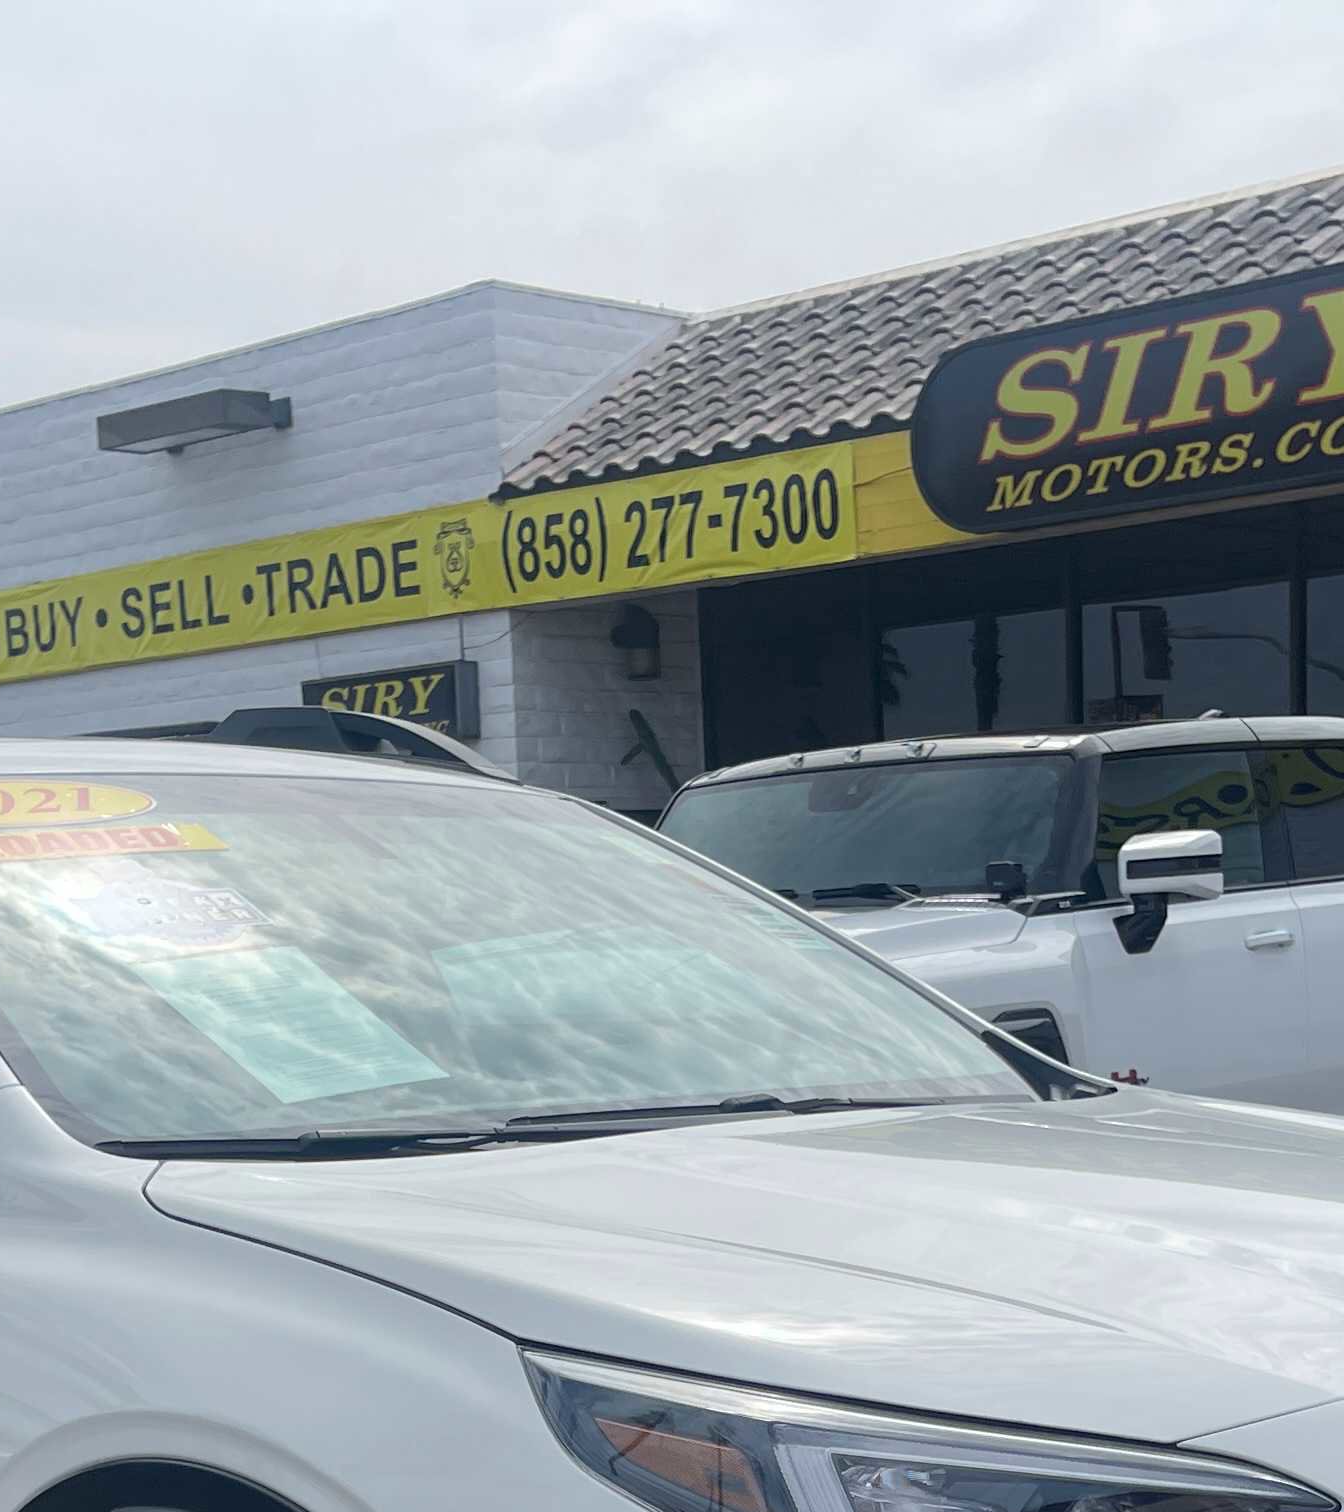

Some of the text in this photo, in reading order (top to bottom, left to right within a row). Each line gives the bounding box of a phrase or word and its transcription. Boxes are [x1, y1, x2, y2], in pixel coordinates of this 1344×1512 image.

[502, 467, 840, 594] (858) 277-7300
[5, 539, 422, 658] BUY SELL TRADE
[321, 673, 445, 717] SIRY
